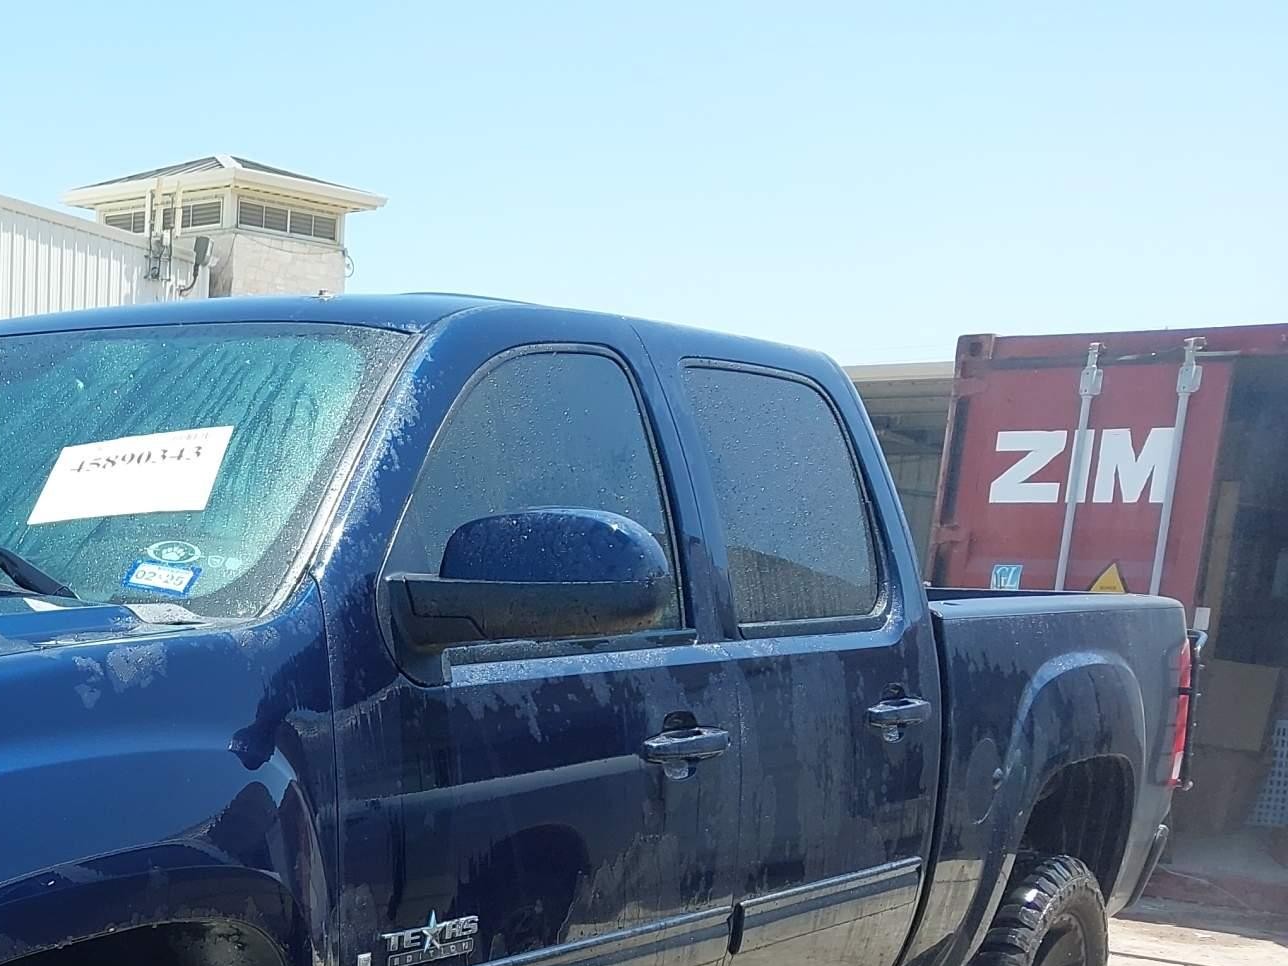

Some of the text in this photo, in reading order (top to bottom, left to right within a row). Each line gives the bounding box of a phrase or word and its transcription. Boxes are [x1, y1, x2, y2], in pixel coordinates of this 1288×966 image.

[71, 446, 202, 472] 45890343
[989, 428, 1177, 503] ZIM
[381, 911, 479, 952] TEXAS
[393, 942, 470, 966] EDITION
